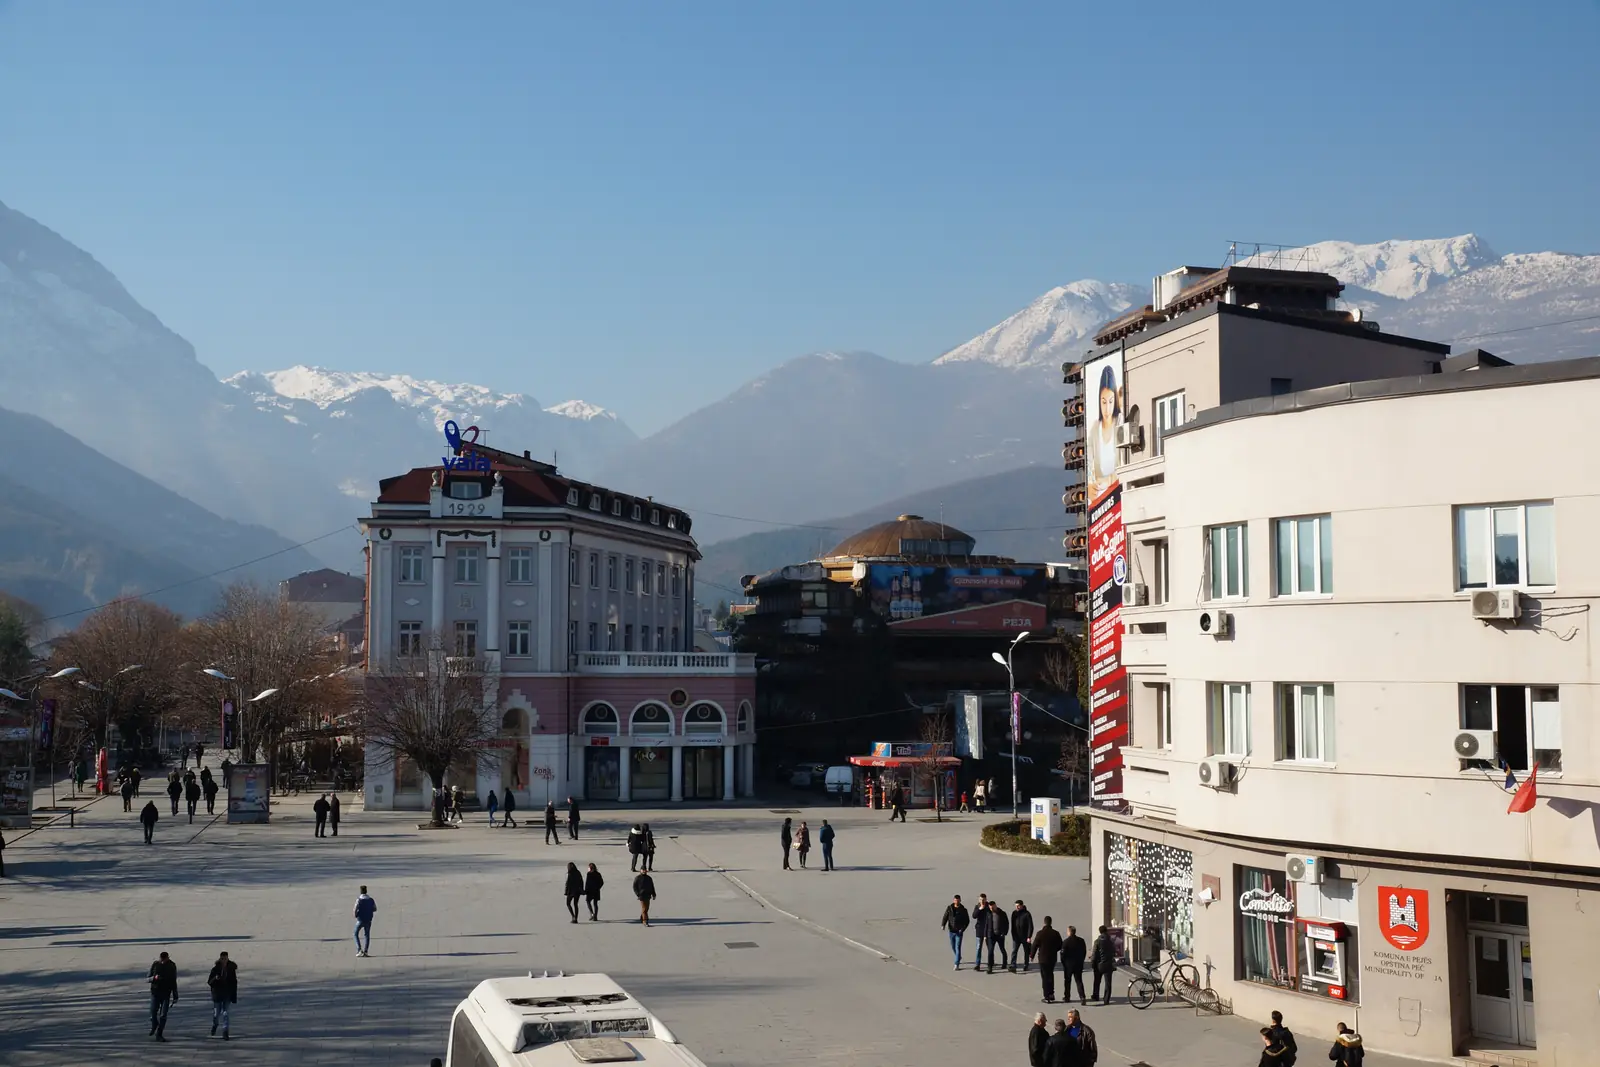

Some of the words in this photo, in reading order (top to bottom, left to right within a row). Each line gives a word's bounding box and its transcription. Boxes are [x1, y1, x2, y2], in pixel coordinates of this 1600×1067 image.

[442, 450, 491, 472] vala
[449, 503, 485, 516] 1929
[1092, 496, 1114, 523] KONKURS
[1003, 618, 1032, 627] PEJA
[1240, 889, 1295, 913] Comodita
[1257, 913, 1279, 923] HOME
[1373, 951, 1404, 962] KOMUNA
[1365, 966, 1412, 978] MUNICIPALITY
